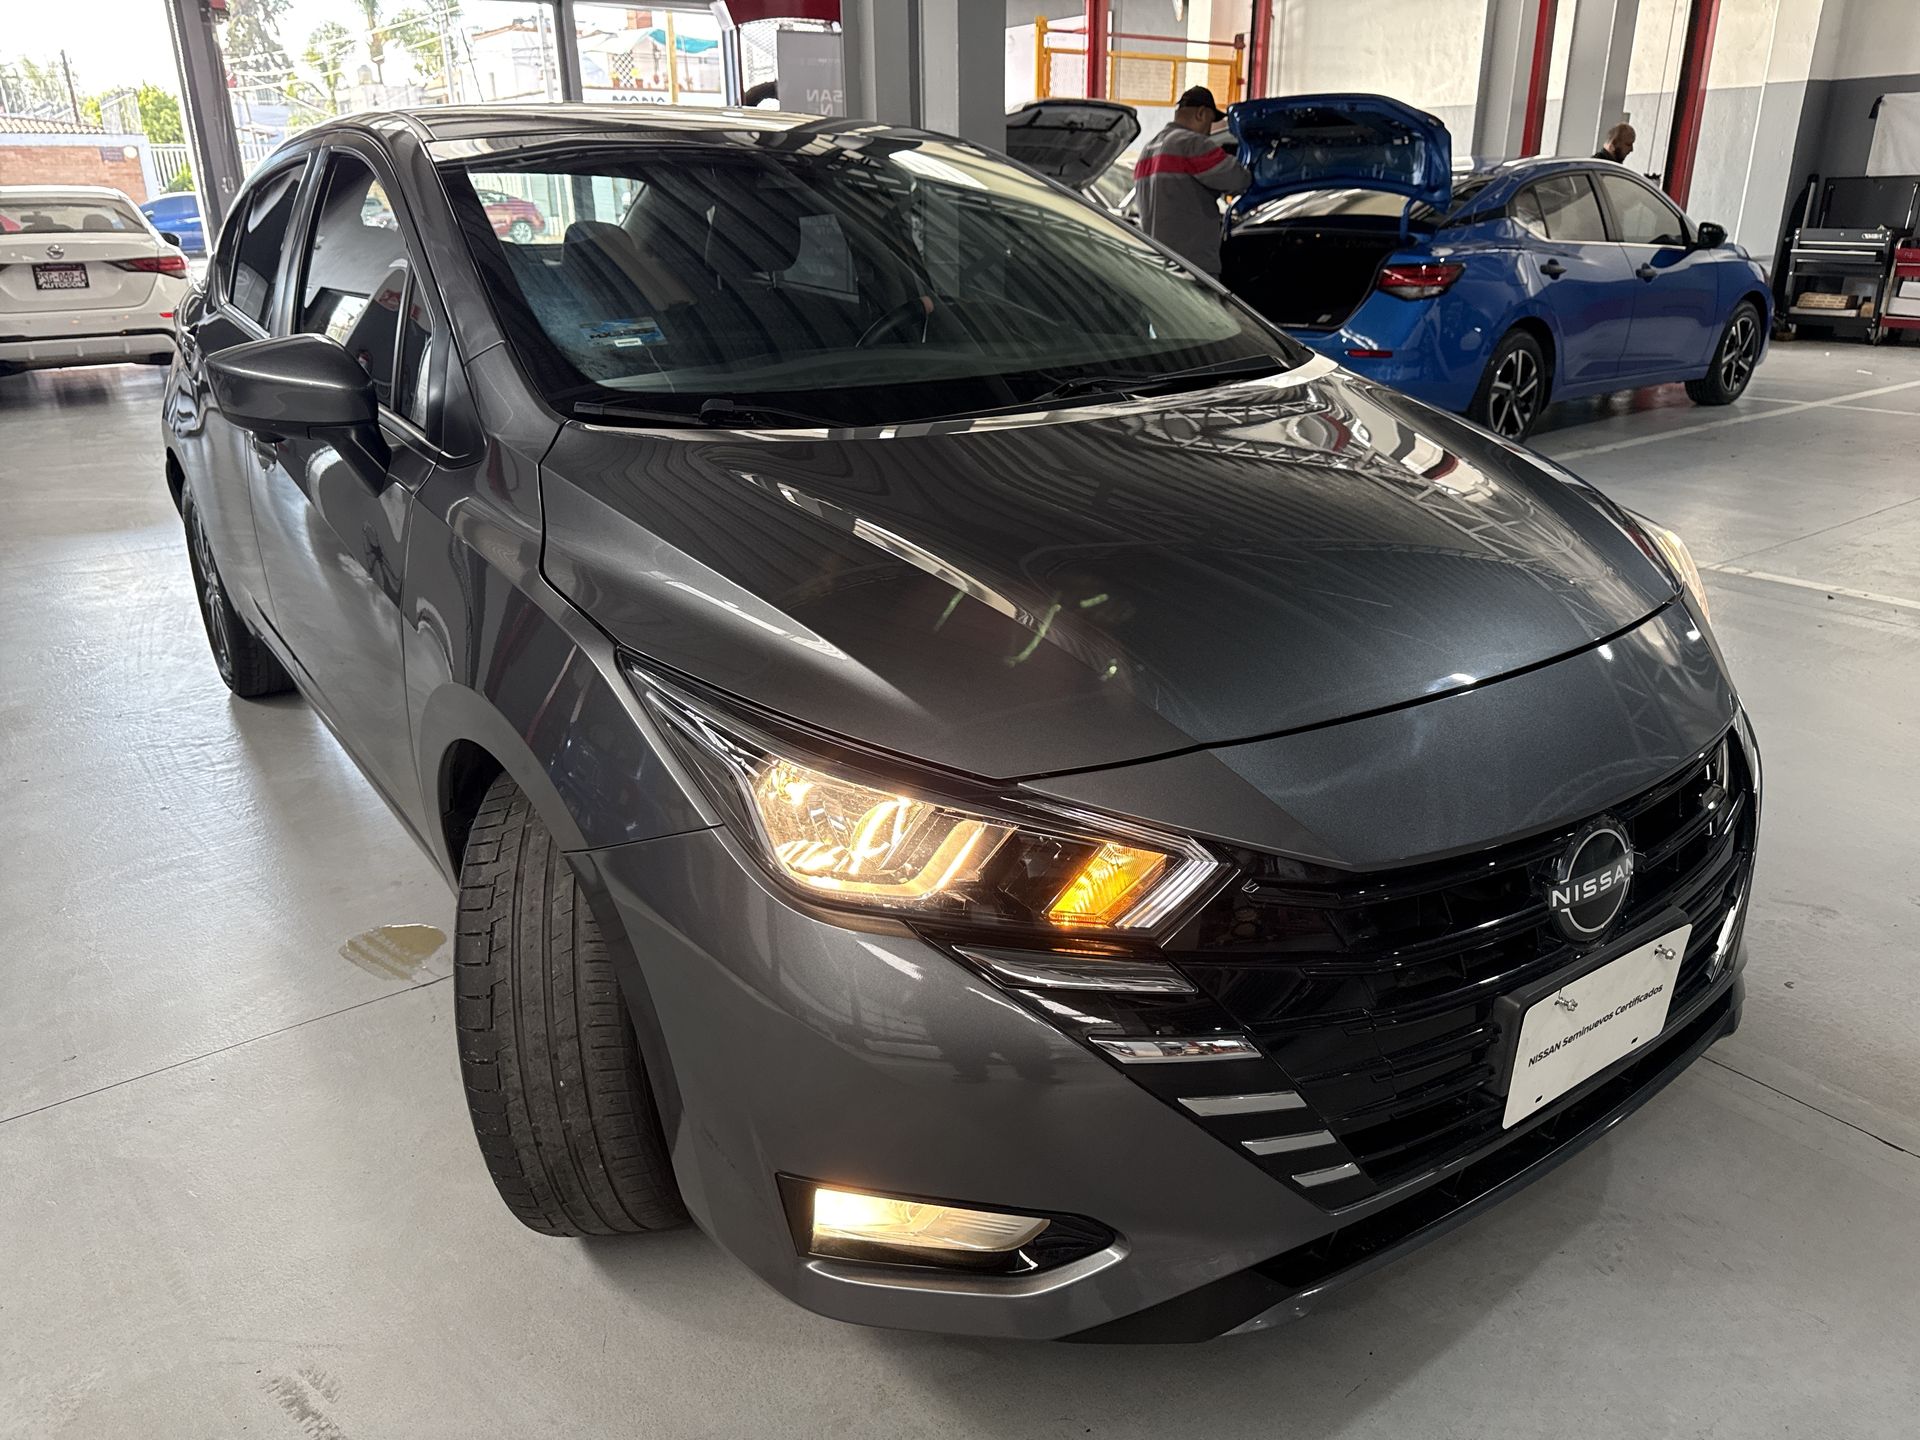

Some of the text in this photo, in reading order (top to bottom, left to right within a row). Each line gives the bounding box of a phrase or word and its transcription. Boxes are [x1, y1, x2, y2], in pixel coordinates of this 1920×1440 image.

[41, 281, 86, 289] AUTOCOM
[1552, 857, 1634, 908] NISSAN
[1528, 984, 1663, 1067] NISSAN Seminuevos Certificados
